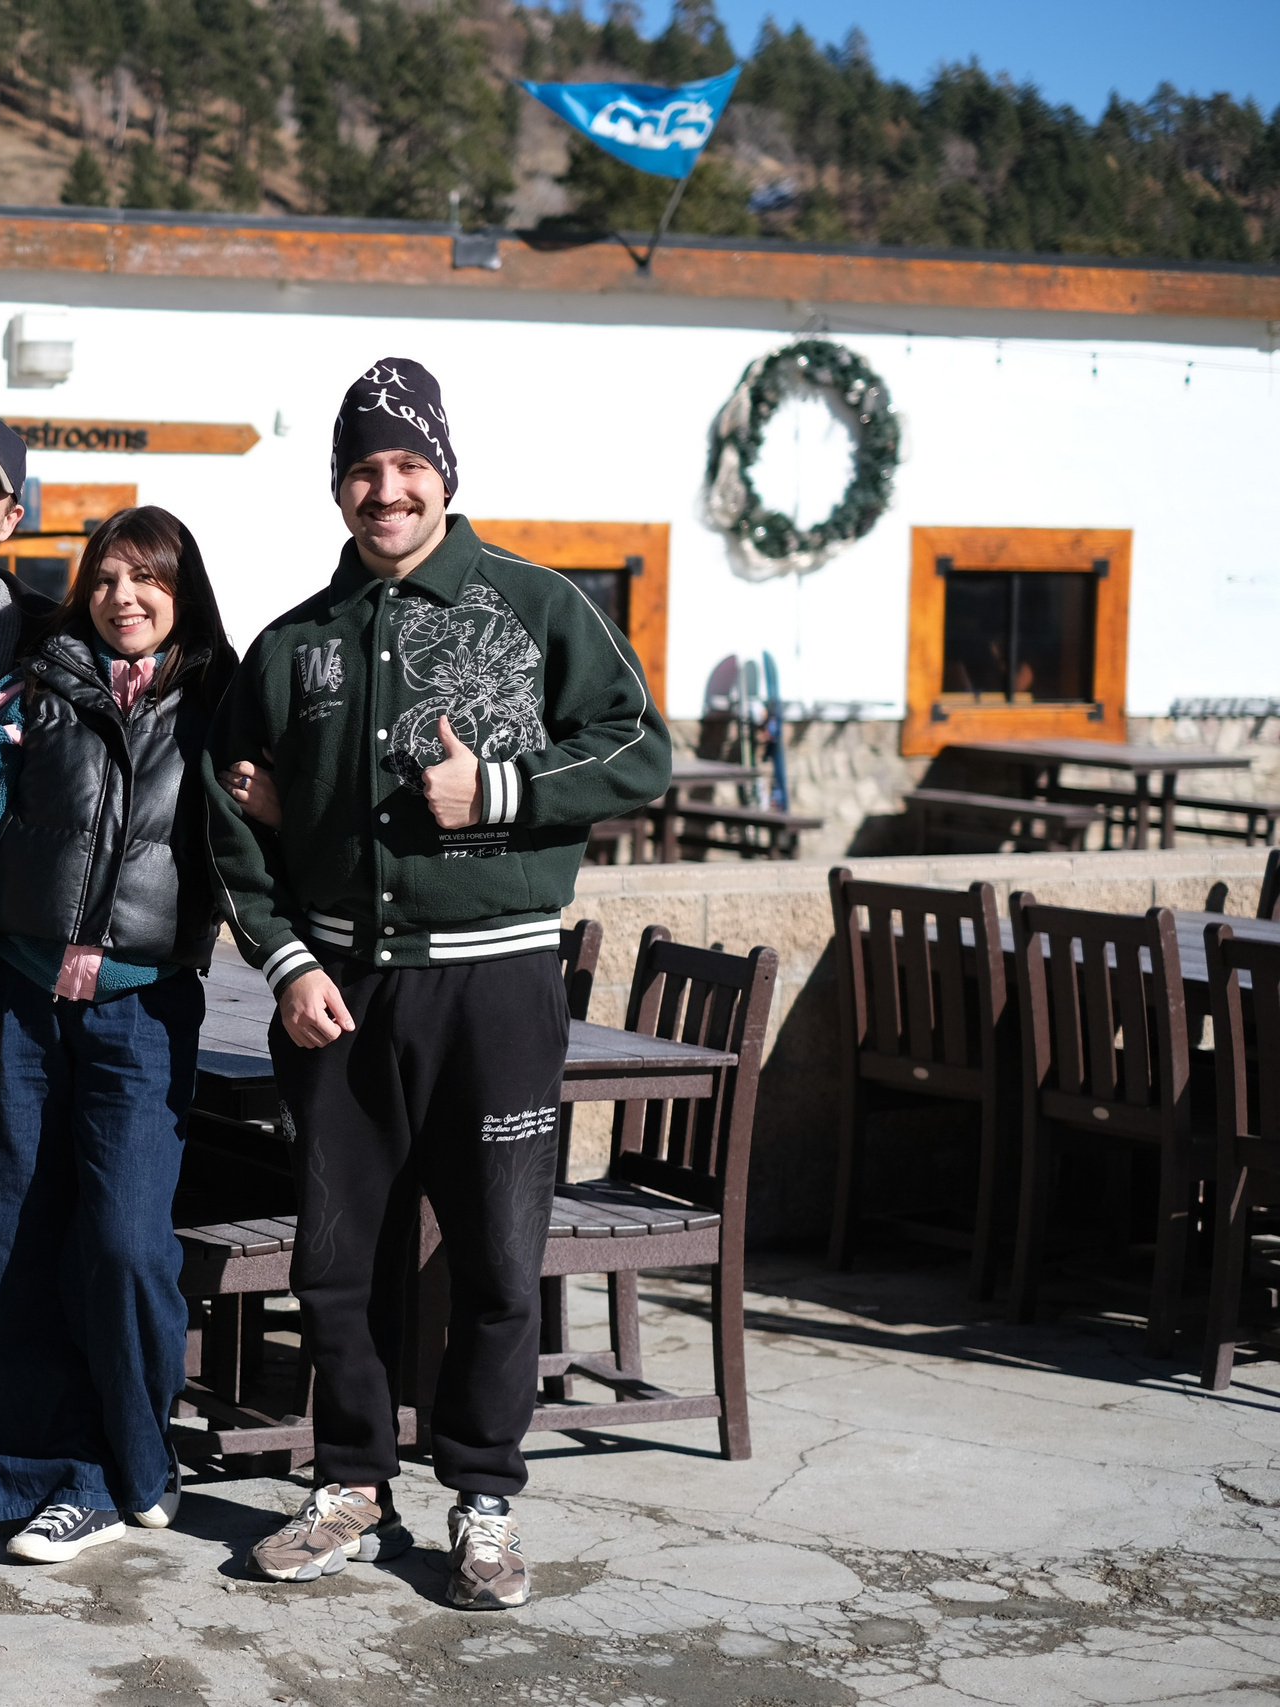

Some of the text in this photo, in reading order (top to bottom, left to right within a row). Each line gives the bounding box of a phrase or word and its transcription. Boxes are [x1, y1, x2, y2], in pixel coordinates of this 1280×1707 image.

[466, 832, 495, 840] FOREVER
[444, 846, 507, 860] ドラゴンボールZ
